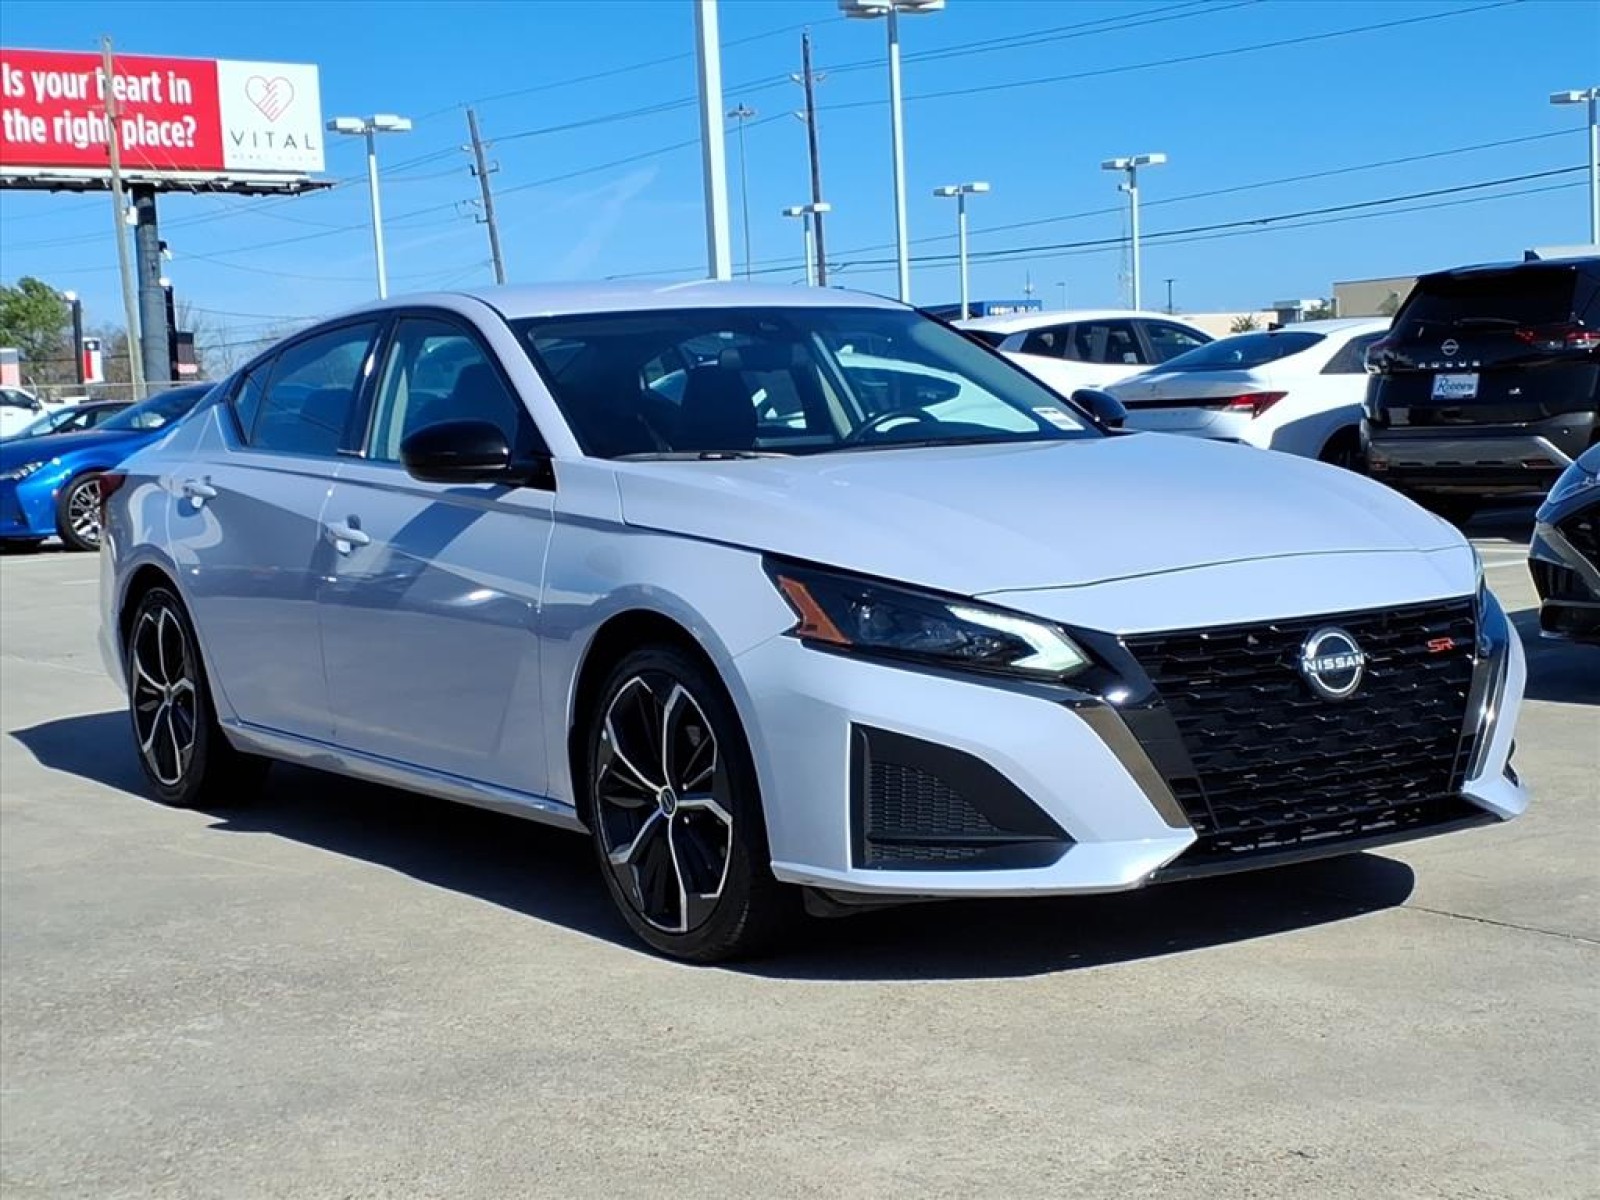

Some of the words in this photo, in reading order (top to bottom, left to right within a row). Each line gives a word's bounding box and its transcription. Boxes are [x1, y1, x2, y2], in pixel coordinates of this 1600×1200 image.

[2, 62, 25, 98] Is
[31, 71, 89, 104] your
[167, 71, 192, 105] in
[2, 108, 47, 143] the
[122, 112, 196, 150] place?
[230, 129, 316, 151] VITAL
[1428, 637, 1455, 653] SR
[1302, 653, 1364, 672] NISSAN
